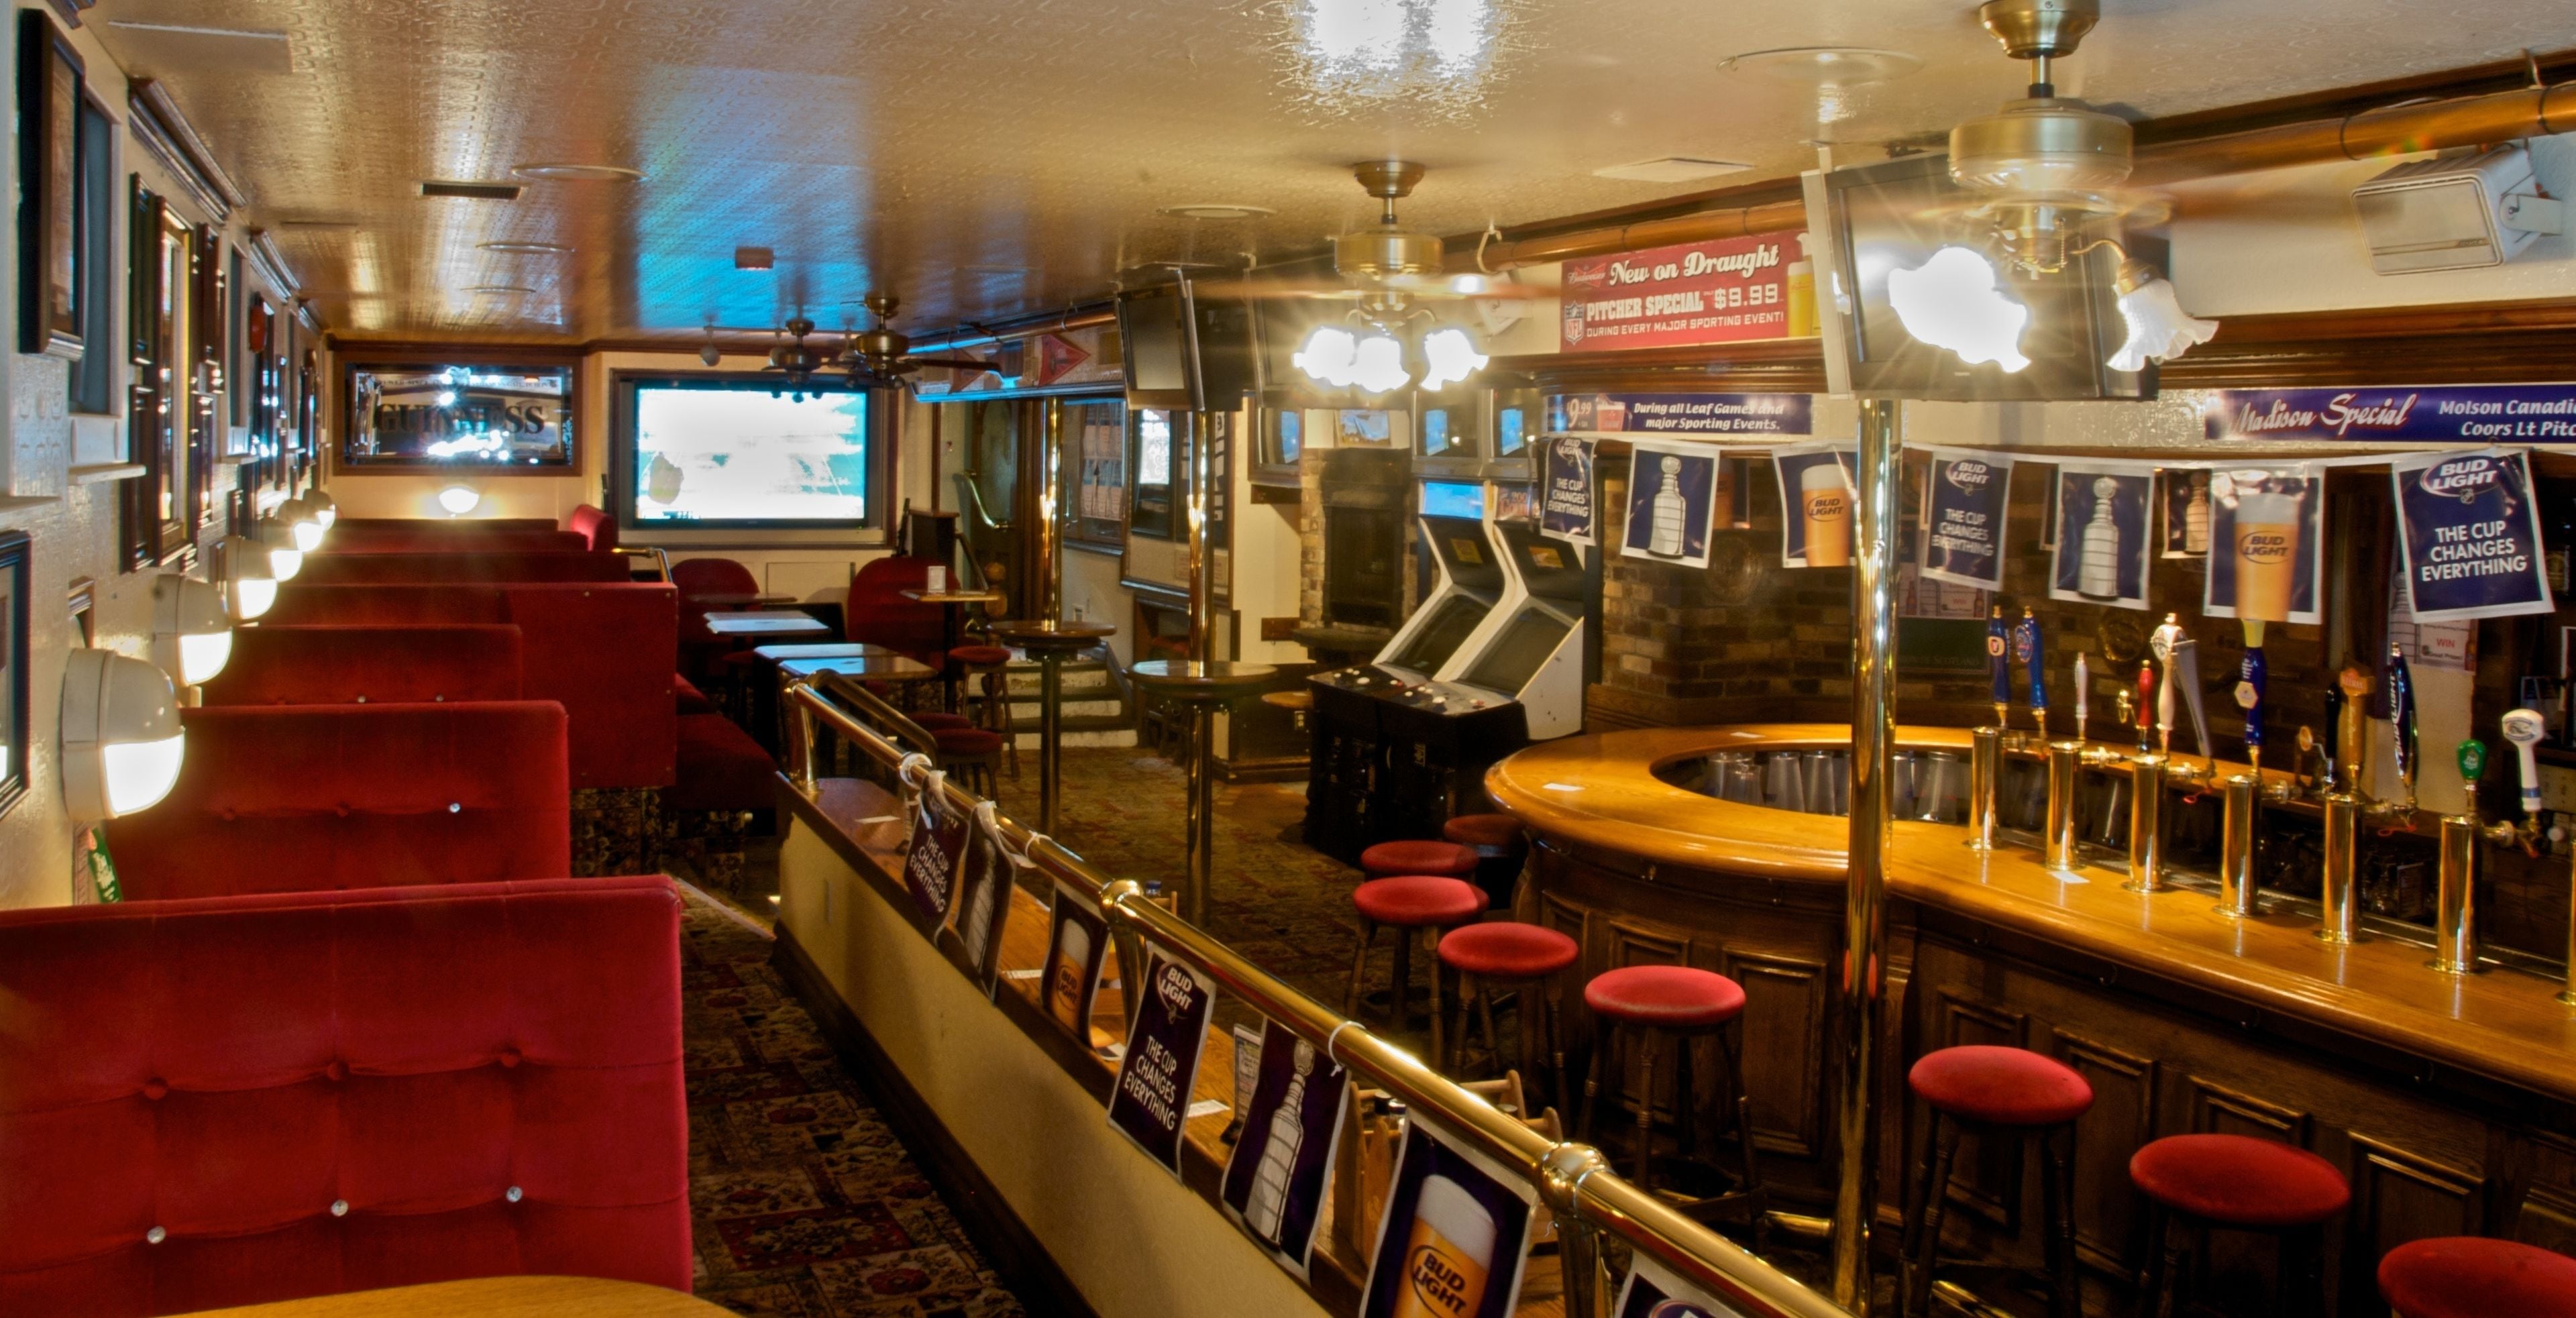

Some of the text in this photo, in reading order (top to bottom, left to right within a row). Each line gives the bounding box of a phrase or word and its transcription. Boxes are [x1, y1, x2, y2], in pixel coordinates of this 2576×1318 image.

[1609, 243, 1780, 286] New on Draught
[1587, 298, 1642, 321] PITCHER
[1646, 290, 1704, 317] SPECIAL
[1715, 283, 1778, 311] $9.99
[1587, 311, 1784, 337] DURING EVERY MAJOR SPORTING EVENT!
[1633, 402, 1785, 415] During all Leaf Games and
[2231, 393, 2417, 436] Madison Special
[2438, 398, 2576, 415] Molson Canadi
[1646, 417, 1780, 431] major Sporting Events.
[2461, 421, 2513, 437] Coors
[2516, 421, 2537, 437] Lt
[1564, 438, 1581, 447] BUD
[1957, 461, 1988, 474] BUD
[2439, 459, 2489, 477] BUD
[1556, 478, 1584, 491] THE CUP
[1951, 470, 1990, 486] LIGHT
[2431, 470, 2498, 491] LIGHT
[1551, 489, 1586, 504] CHANGES
[1815, 498, 1841, 508] BUD
[1547, 499, 1589, 518] EVERYTHING
[1810, 506, 1844, 516] LIGHT
[1945, 508, 1987, 526] THE CUP
[1939, 522, 1990, 541] CHANGES
[2251, 536, 2284, 545] BUD
[2435, 520, 2506, 543] THE CUP
[1931, 535, 1994, 557] EVERYTHING
[2243, 547, 2288, 556] LIGHT
[2430, 538, 2516, 563] CHANGES
[2420, 555, 2528, 582] EVERYTHING
[2436, 638, 2455, 649] WIN
[926, 834, 949, 873] THE CUP
[910, 854, 947, 913] EVERYTHING
[1167, 967, 1193, 992] BUD
[1159, 979, 1193, 1011] LIGHT
[1146, 1035, 1177, 1077] THE CUP
[1136, 1054, 1175, 1104] CHANGES
[1124, 1070, 1175, 1131] EVERYTHING
[1424, 1252, 1466, 1293] BUD
[1412, 1264, 1467, 1315] LIGHT
